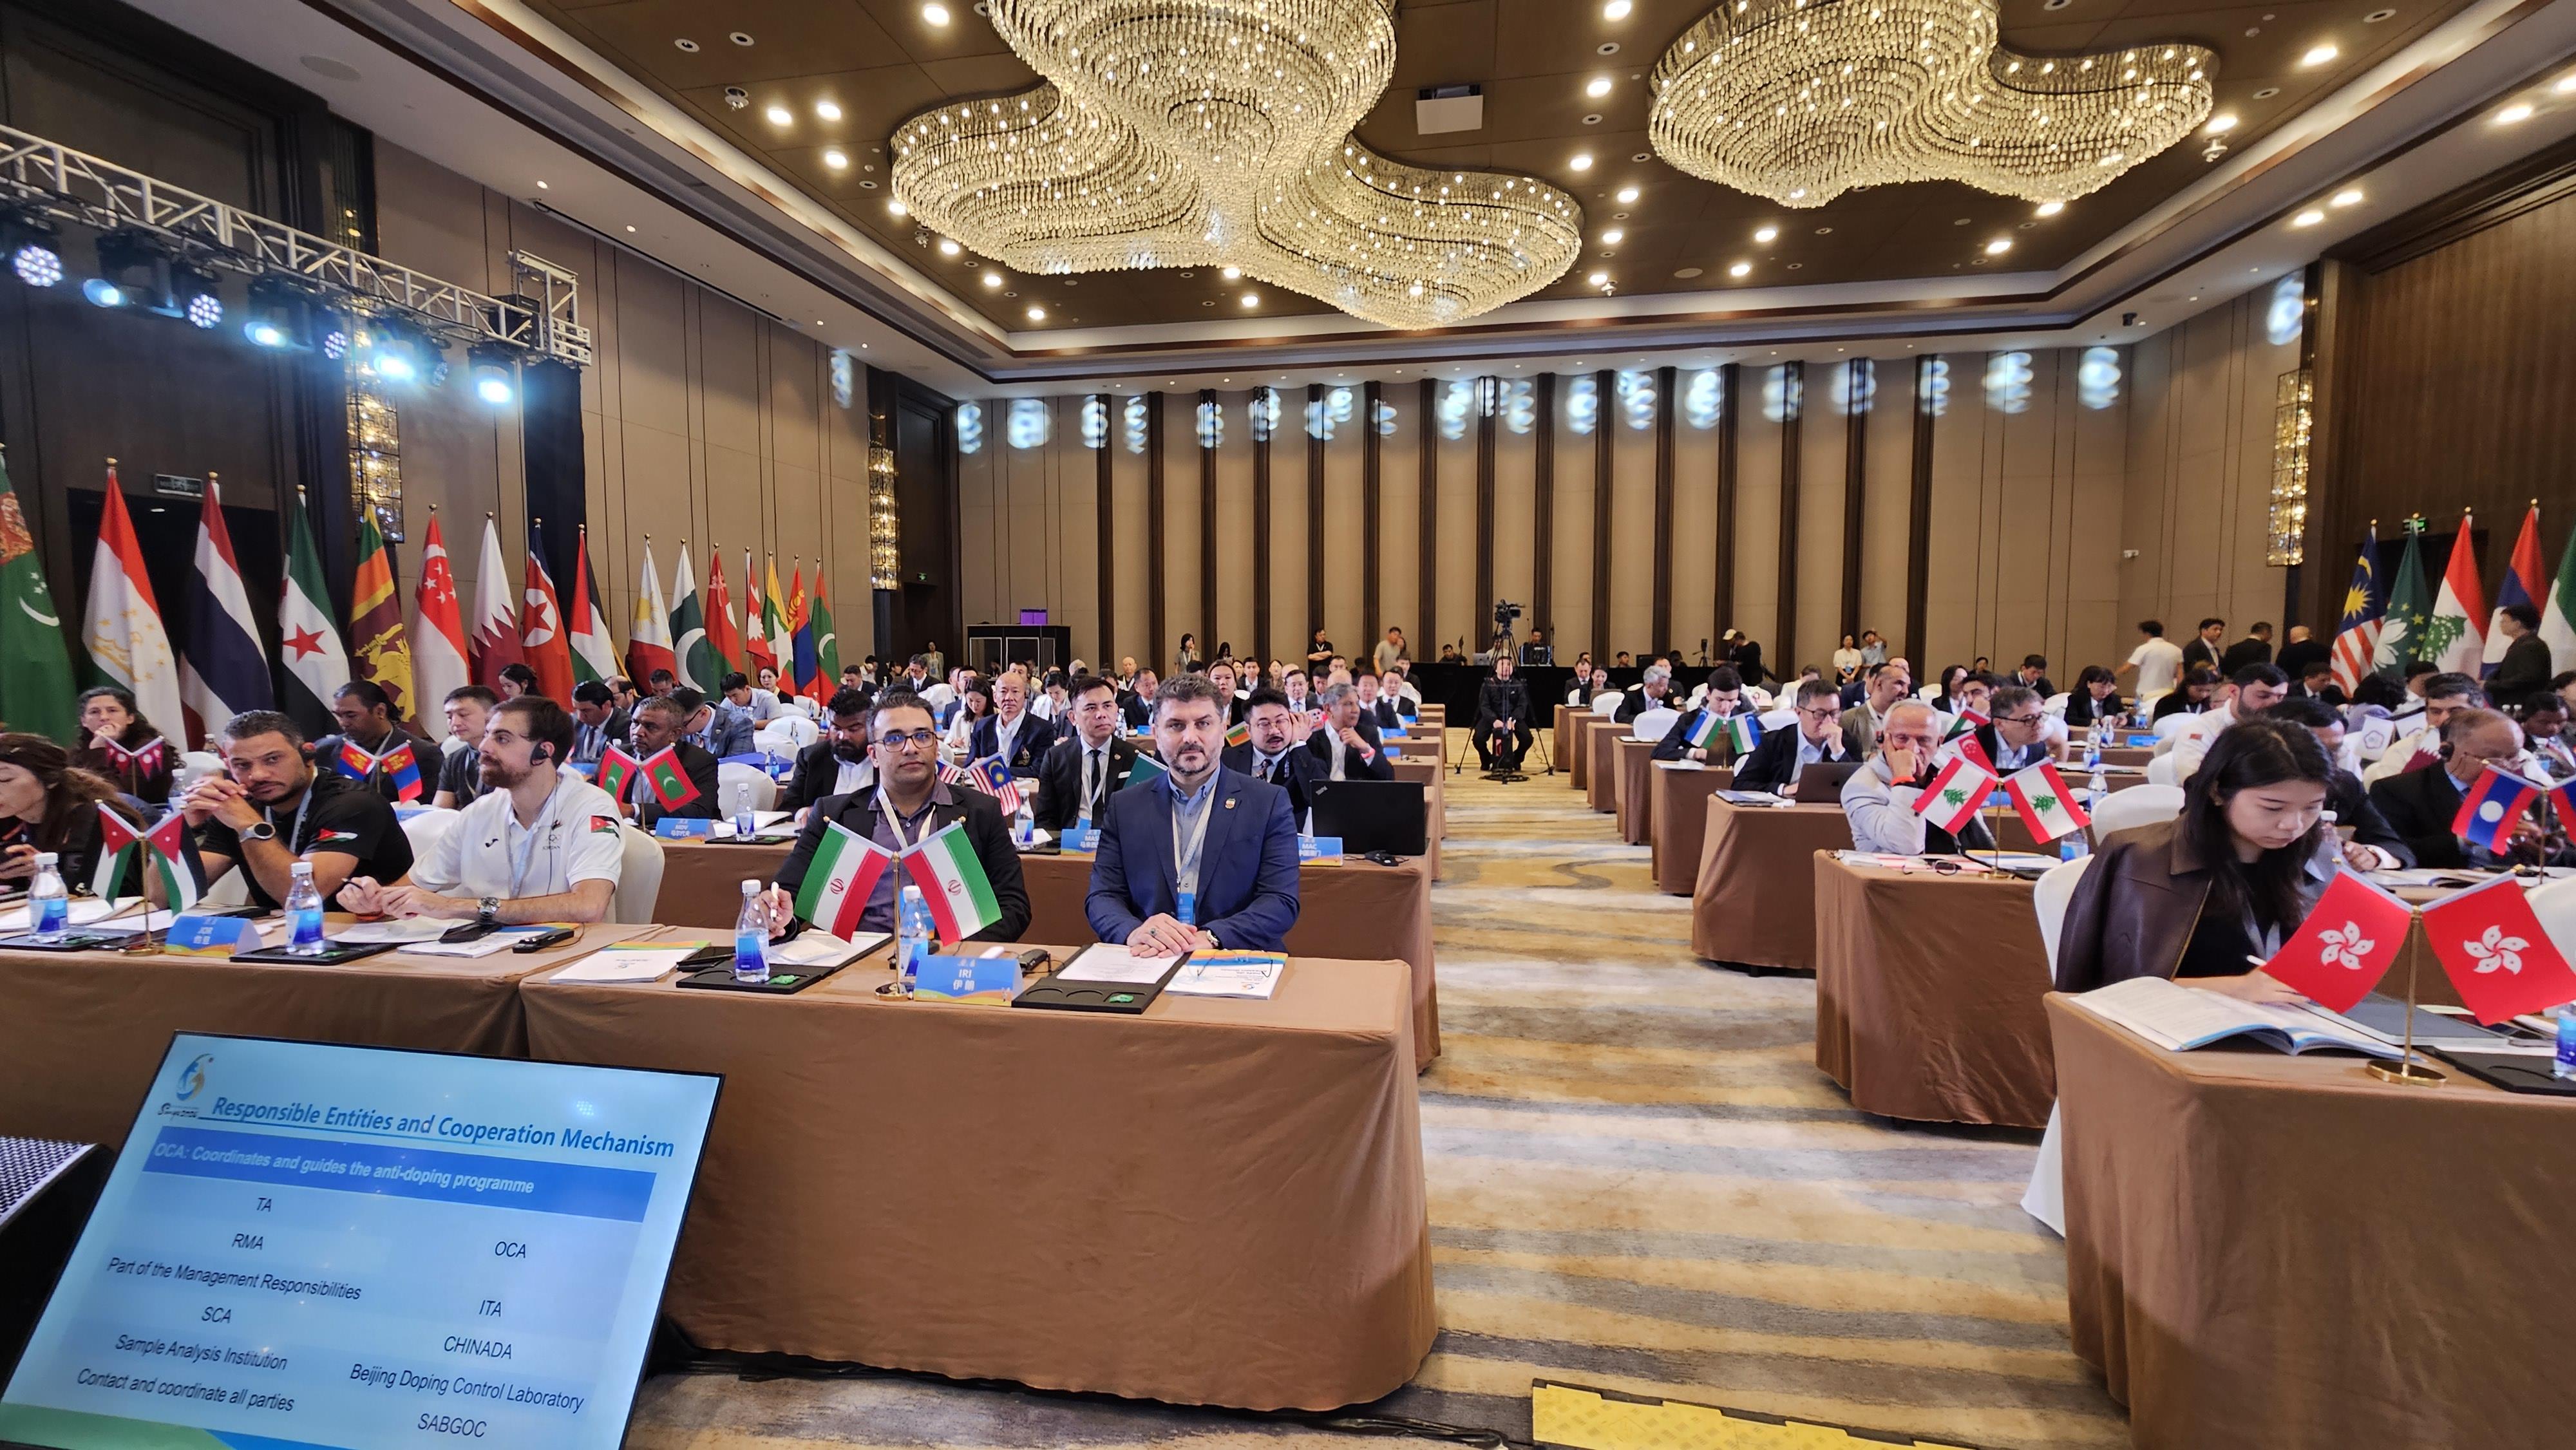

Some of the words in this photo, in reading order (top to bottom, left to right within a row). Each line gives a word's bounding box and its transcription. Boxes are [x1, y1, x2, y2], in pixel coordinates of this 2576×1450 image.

[952, 979, 975, 991] 伊朗
[958, 969, 972, 978] IRI
[213, 1097, 321, 1123] Responsible
[325, 1107, 394, 1130] Entities
[397, 1115, 436, 1134] and
[438, 1117, 555, 1146] Cooperation
[560, 1128, 675, 1157] Mechanism
[154, 1143, 190, 1159] OCA:
[193, 1146, 271, 1167] Coordinates
[273, 1156, 300, 1169] and
[300, 1158, 346, 1174] guides
[349, 1161, 372, 1176] the
[374, 1165, 452, 1188] anti-doping
[453, 1176, 535, 1194] programme
[257, 1198, 272, 1212] TA
[232, 1234, 264, 1250] RMA
[495, 1241, 527, 1258] OCA
[106, 1257, 135, 1274] Part
[137, 1261, 154, 1276] of
[151, 1264, 173, 1277] the
[174, 1265, 259, 1288] Management
[260, 1274, 362, 1300] Responsibilities
[201, 1306, 232, 1324] SCA
[479, 1299, 502, 1317] ITA
[115, 1334, 165, 1357] Sample
[166, 1341, 222, 1363] Analysis
[223, 1347, 288, 1370] Institution
[443, 1335, 513, 1359] CHINADA
[77, 1368, 129, 1389] Contact
[129, 1377, 158, 1393] and
[158, 1382, 227, 1402] coordinate
[229, 1388, 248, 1404] all
[246, 1392, 294, 1411] parties
[350, 1364, 397, 1388] Beijing
[399, 1370, 449, 1396] Doping
[453, 1377, 506, 1399] Control
[507, 1384, 585, 1414] Laboratory
[417, 1413, 488, 1438] SABGOC
